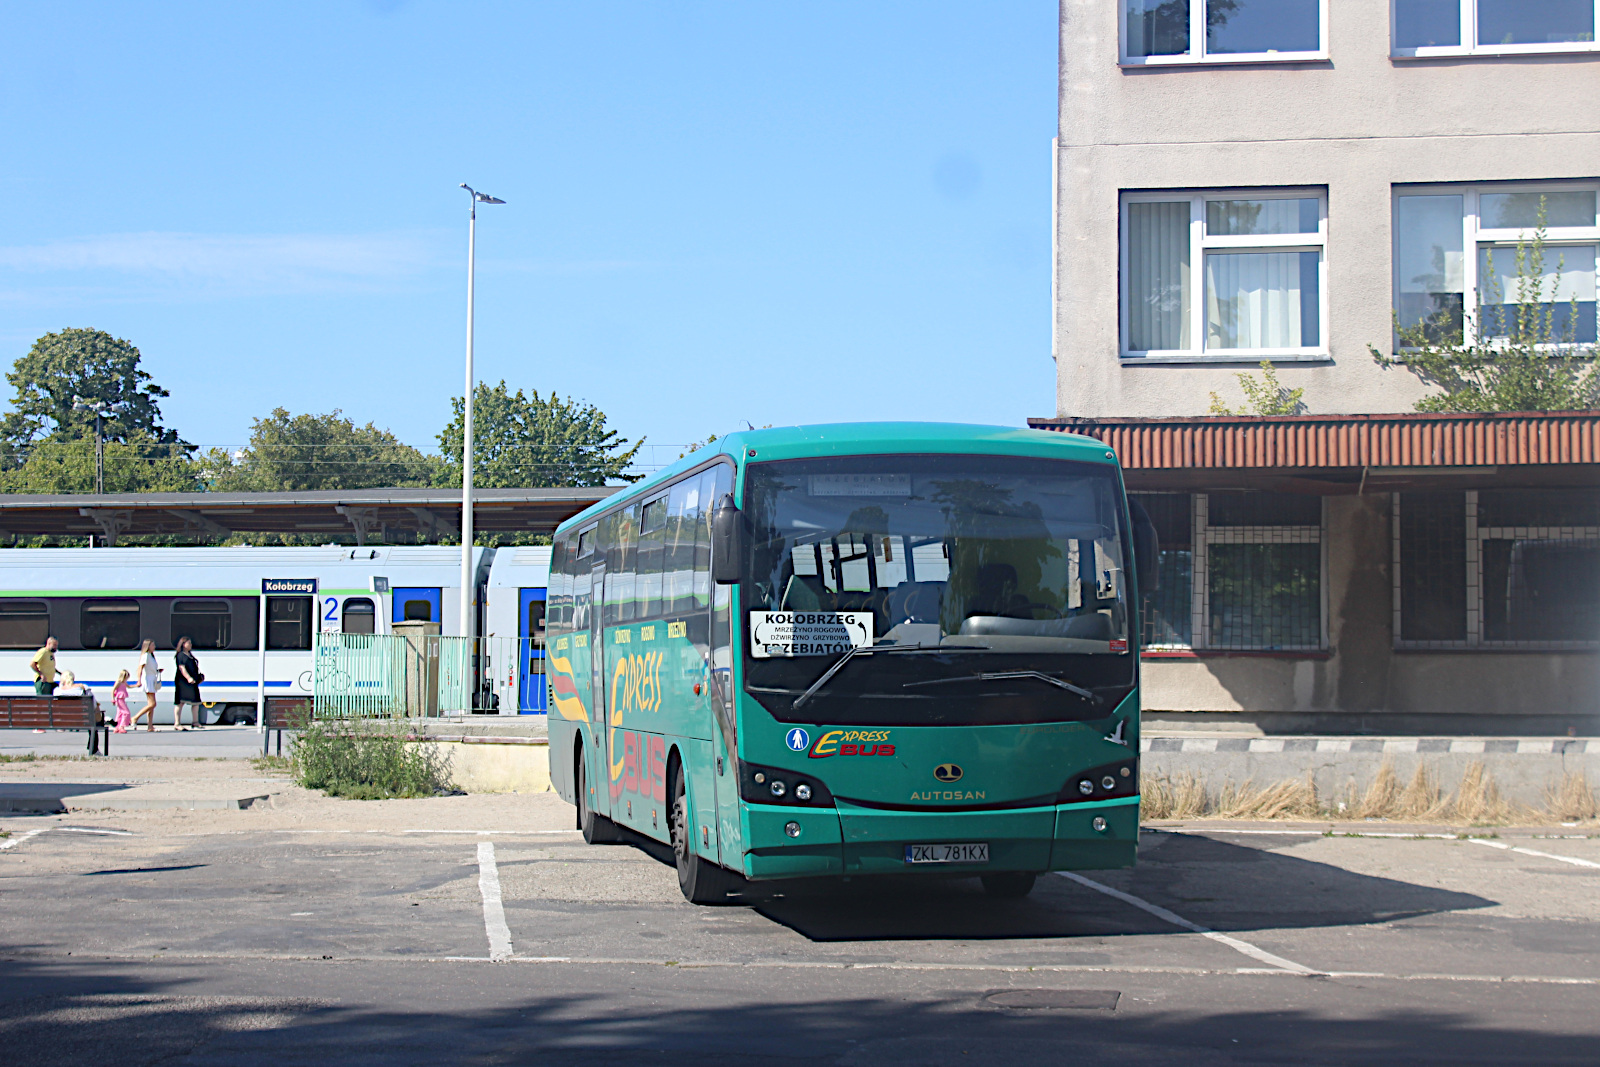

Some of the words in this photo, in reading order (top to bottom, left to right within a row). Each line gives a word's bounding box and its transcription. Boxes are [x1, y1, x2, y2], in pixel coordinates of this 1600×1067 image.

[265, 582, 314, 593] Kołobrzeg
[324, 597, 338, 621] 2
[765, 614, 856, 625] KOŁOBRZEG
[774, 625, 813, 633] MRZEŻYNO
[770, 633, 809, 641] DŹWIRZYNO
[815, 730, 891, 754] EXPRESS
[839, 744, 896, 756] BUS
[623, 731, 666, 804] BUS
[910, 790, 986, 801] AUTOSAN
[913, 846, 940, 861] ZKL
[944, 845, 987, 860] 781KX
